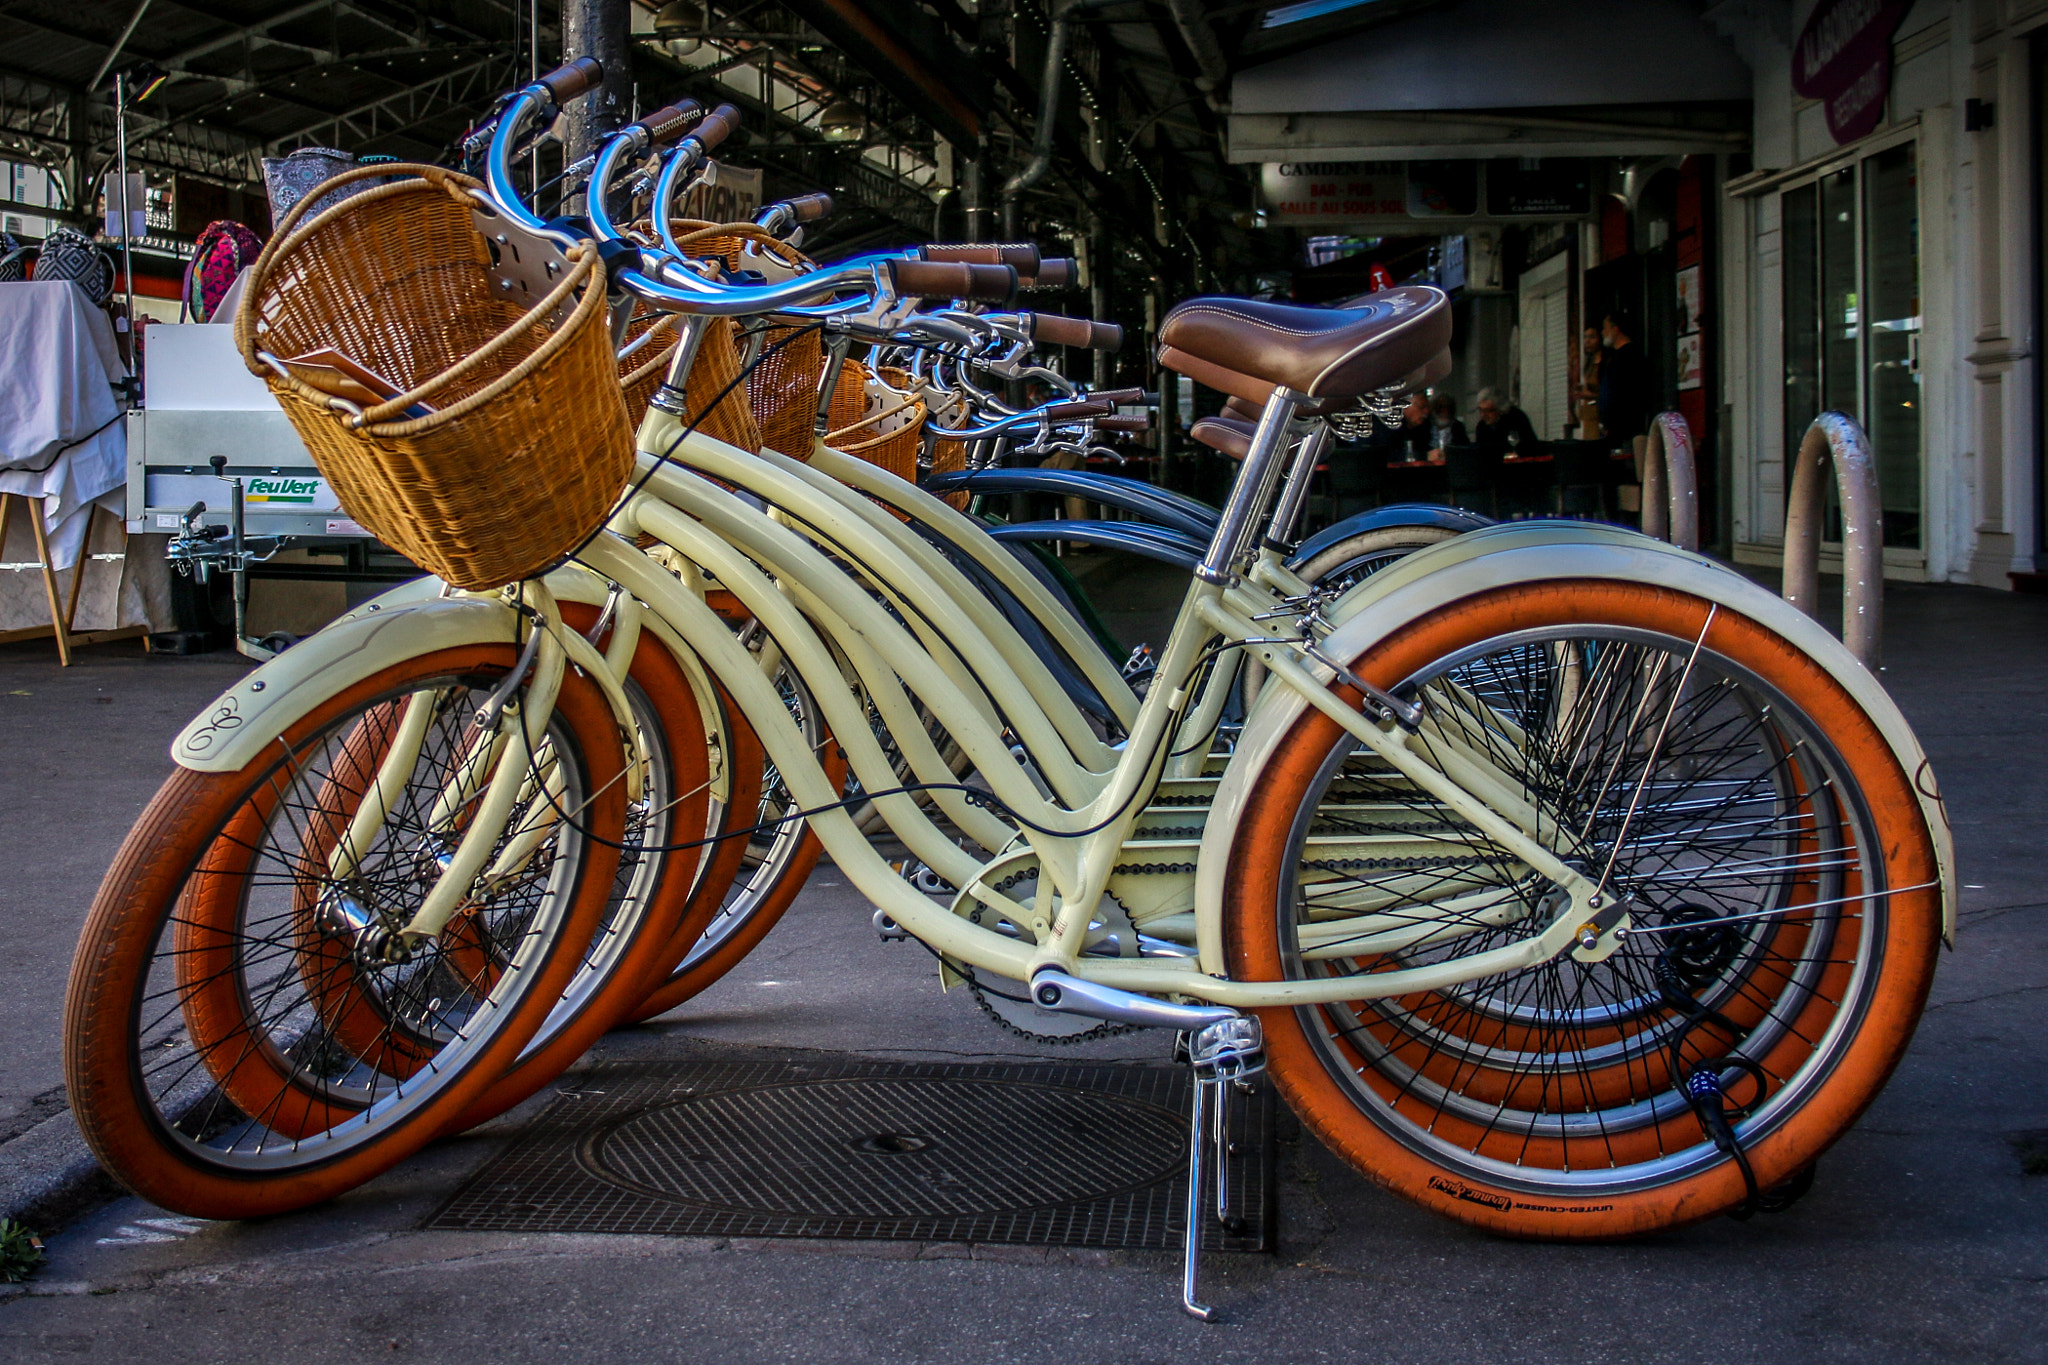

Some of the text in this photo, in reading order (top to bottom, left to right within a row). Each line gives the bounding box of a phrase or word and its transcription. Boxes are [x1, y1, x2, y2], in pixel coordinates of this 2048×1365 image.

[1279, 161, 1403, 176] CAMDEN BAR
[1310, 183, 1337, 197] BAR
[1347, 183, 1374, 197] PUB
[1279, 199, 1406, 215] SALLE AU SOUS SOL
